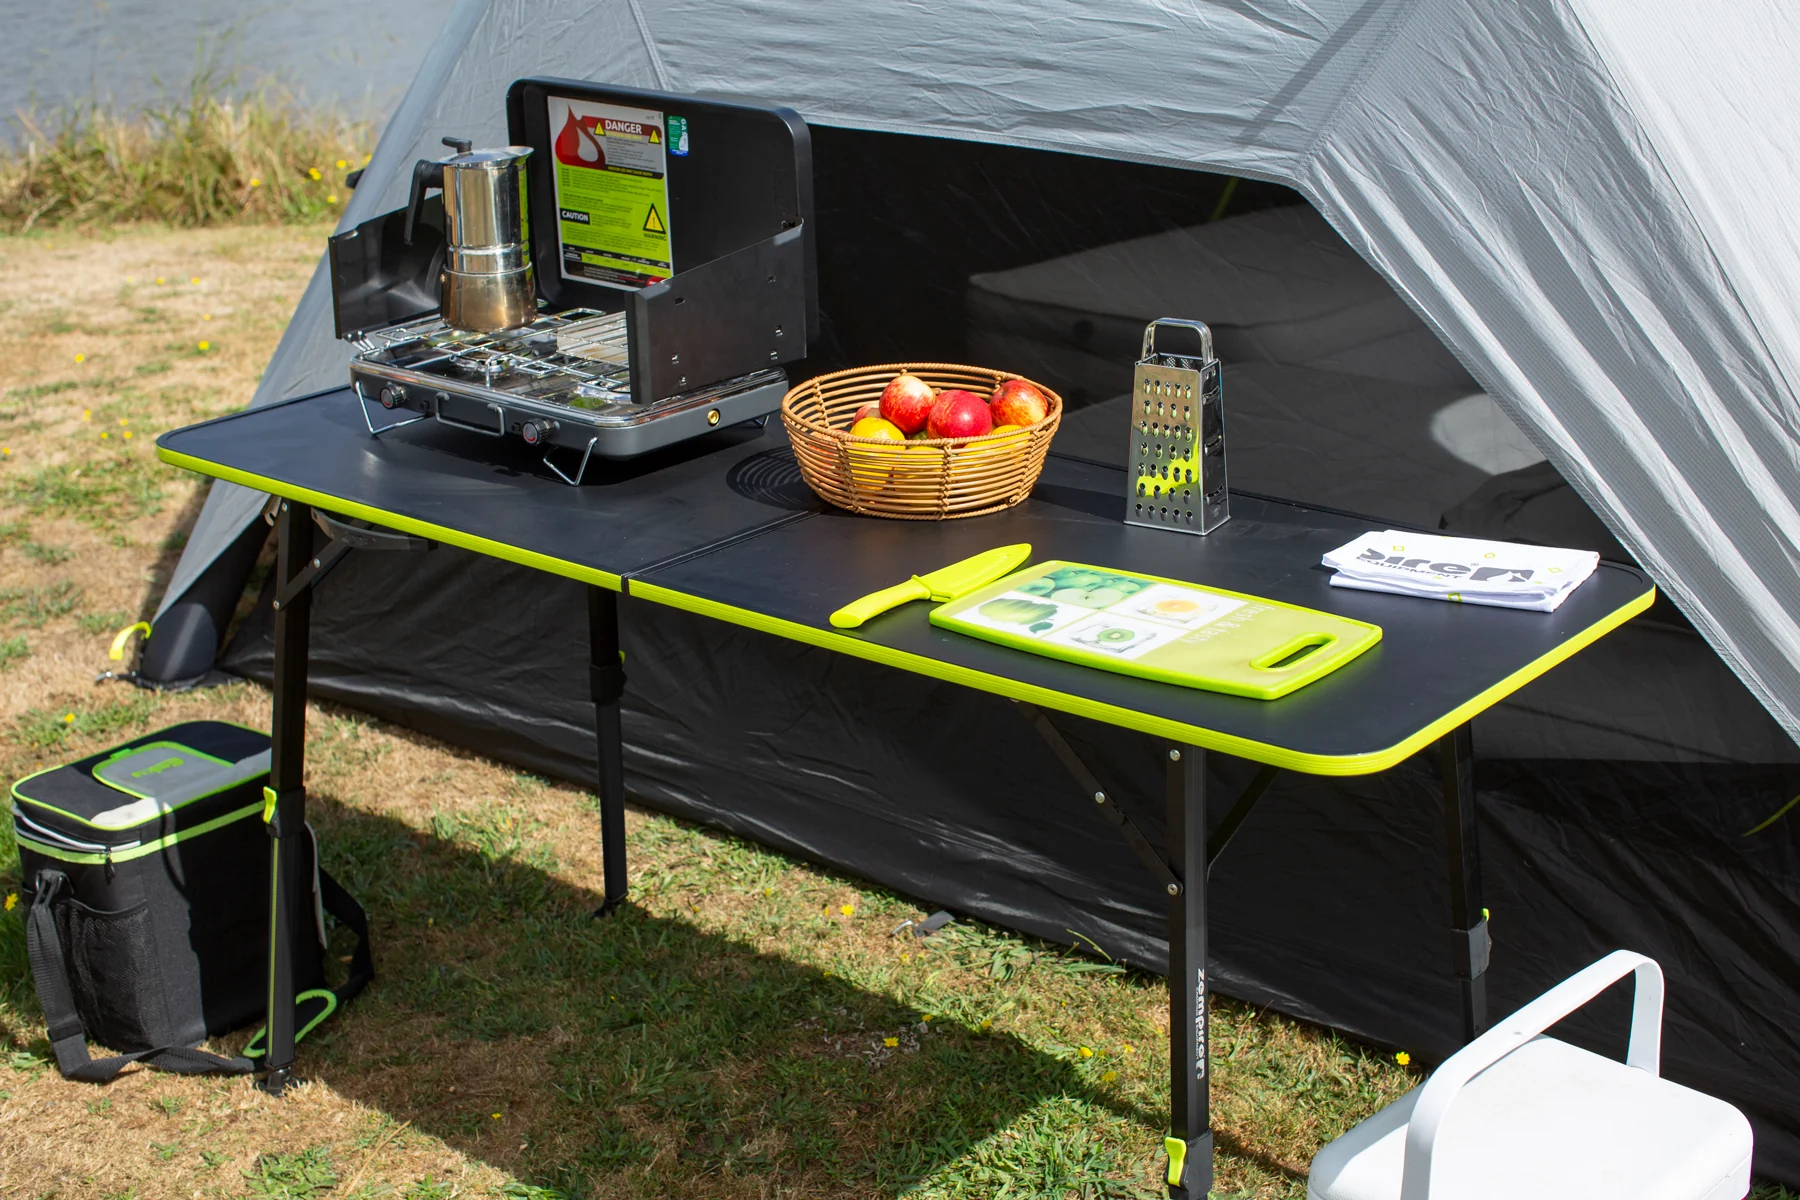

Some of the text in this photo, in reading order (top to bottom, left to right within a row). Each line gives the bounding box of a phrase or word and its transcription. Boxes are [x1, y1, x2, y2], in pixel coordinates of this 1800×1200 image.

[605, 119, 642, 134] DANGER
[562, 210, 589, 222] CAUTION
[643, 233, 667, 241] WARNING
[1356, 556, 1462, 579] EQUIPMENT
[1195, 968, 1205, 1059] zempire
